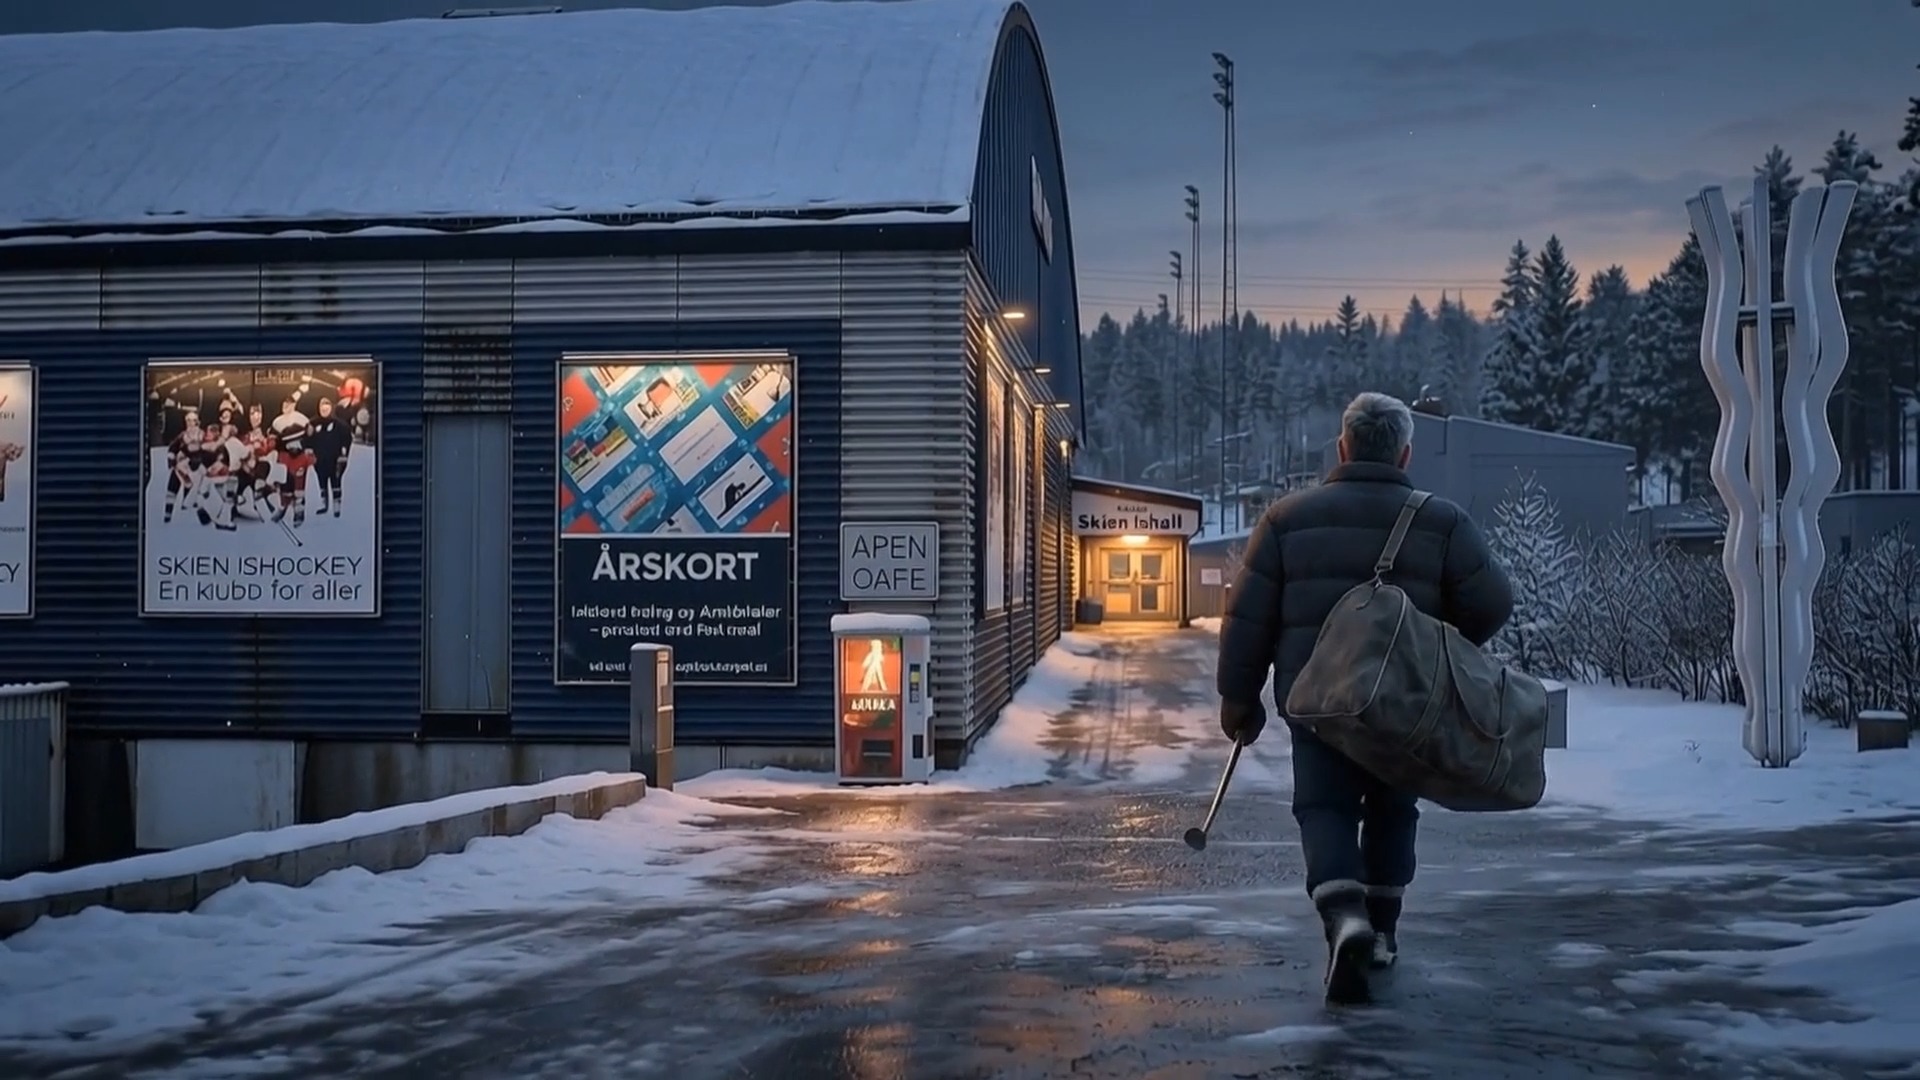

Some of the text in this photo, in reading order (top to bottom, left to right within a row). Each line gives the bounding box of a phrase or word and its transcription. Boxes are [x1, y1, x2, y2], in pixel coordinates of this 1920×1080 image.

[1078, 513, 1128, 530] Skien
[851, 534, 927, 559] APEN
[158, 556, 363, 576] SKIEN ISHOCKEY
[592, 542, 760, 581] ÅRSKORT
[159, 580, 189, 601] En
[271, 579, 305, 601] for
[311, 579, 363, 601] aller
